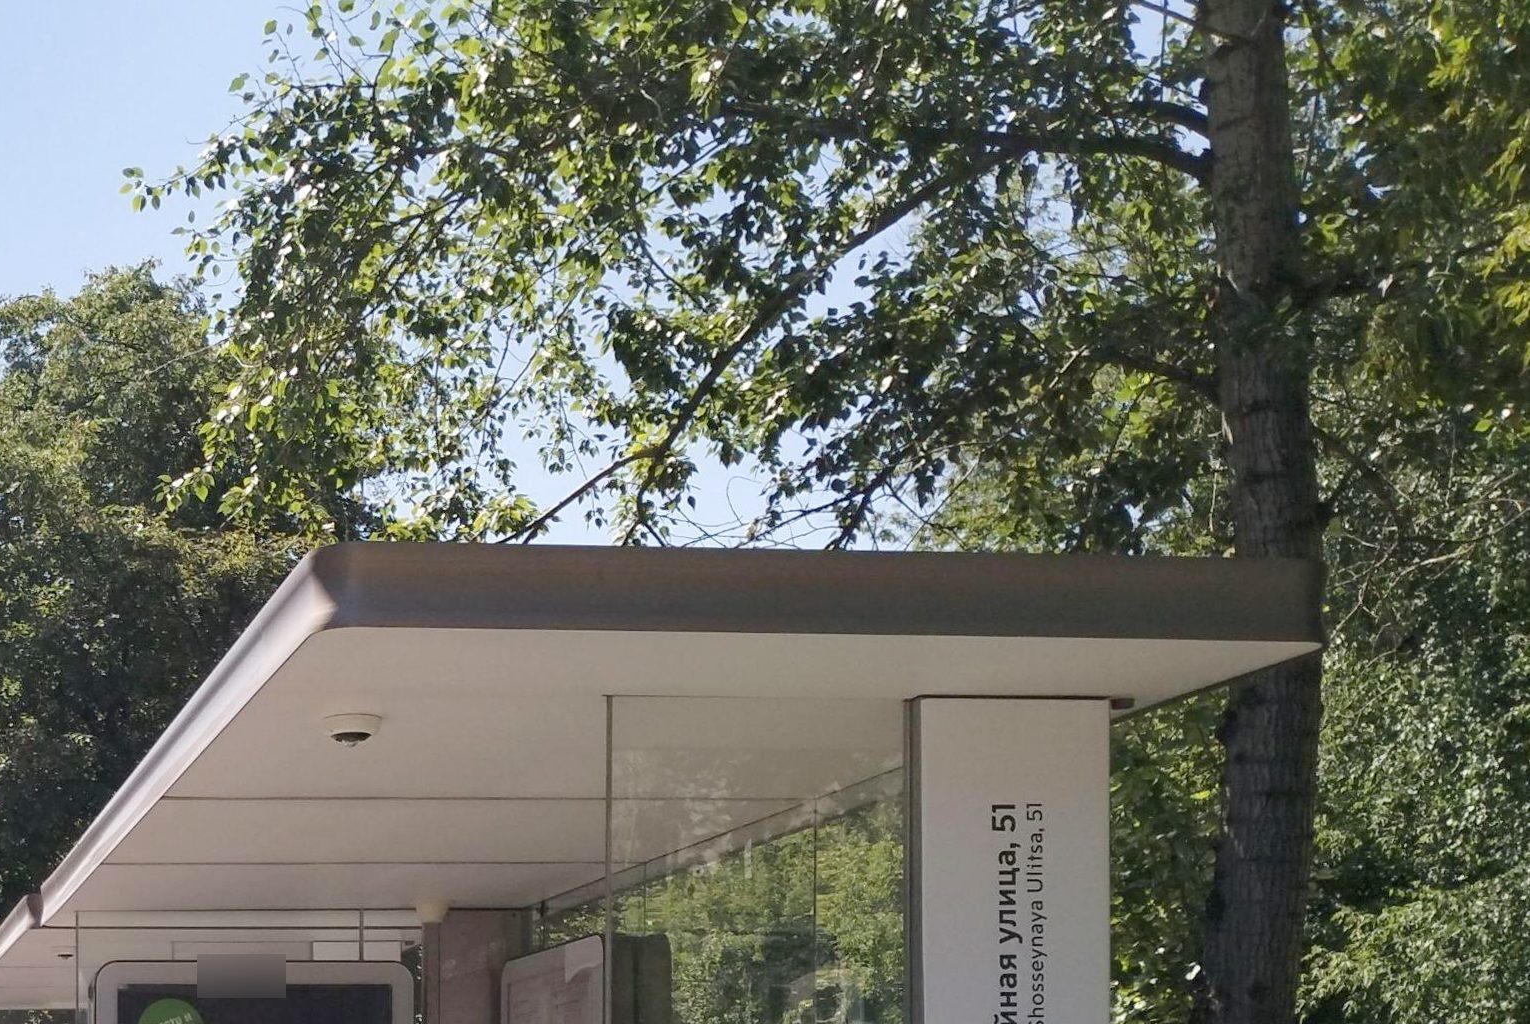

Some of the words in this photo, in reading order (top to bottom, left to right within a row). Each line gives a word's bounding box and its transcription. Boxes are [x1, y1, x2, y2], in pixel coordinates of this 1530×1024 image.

[991, 803, 1016, 832] 51
[1026, 803, 1043, 821] 51
[1026, 828, 1045, 893] Ulitsa,
[998, 842, 1023, 944] улица,
[184, 1012, 193, 1023] и
